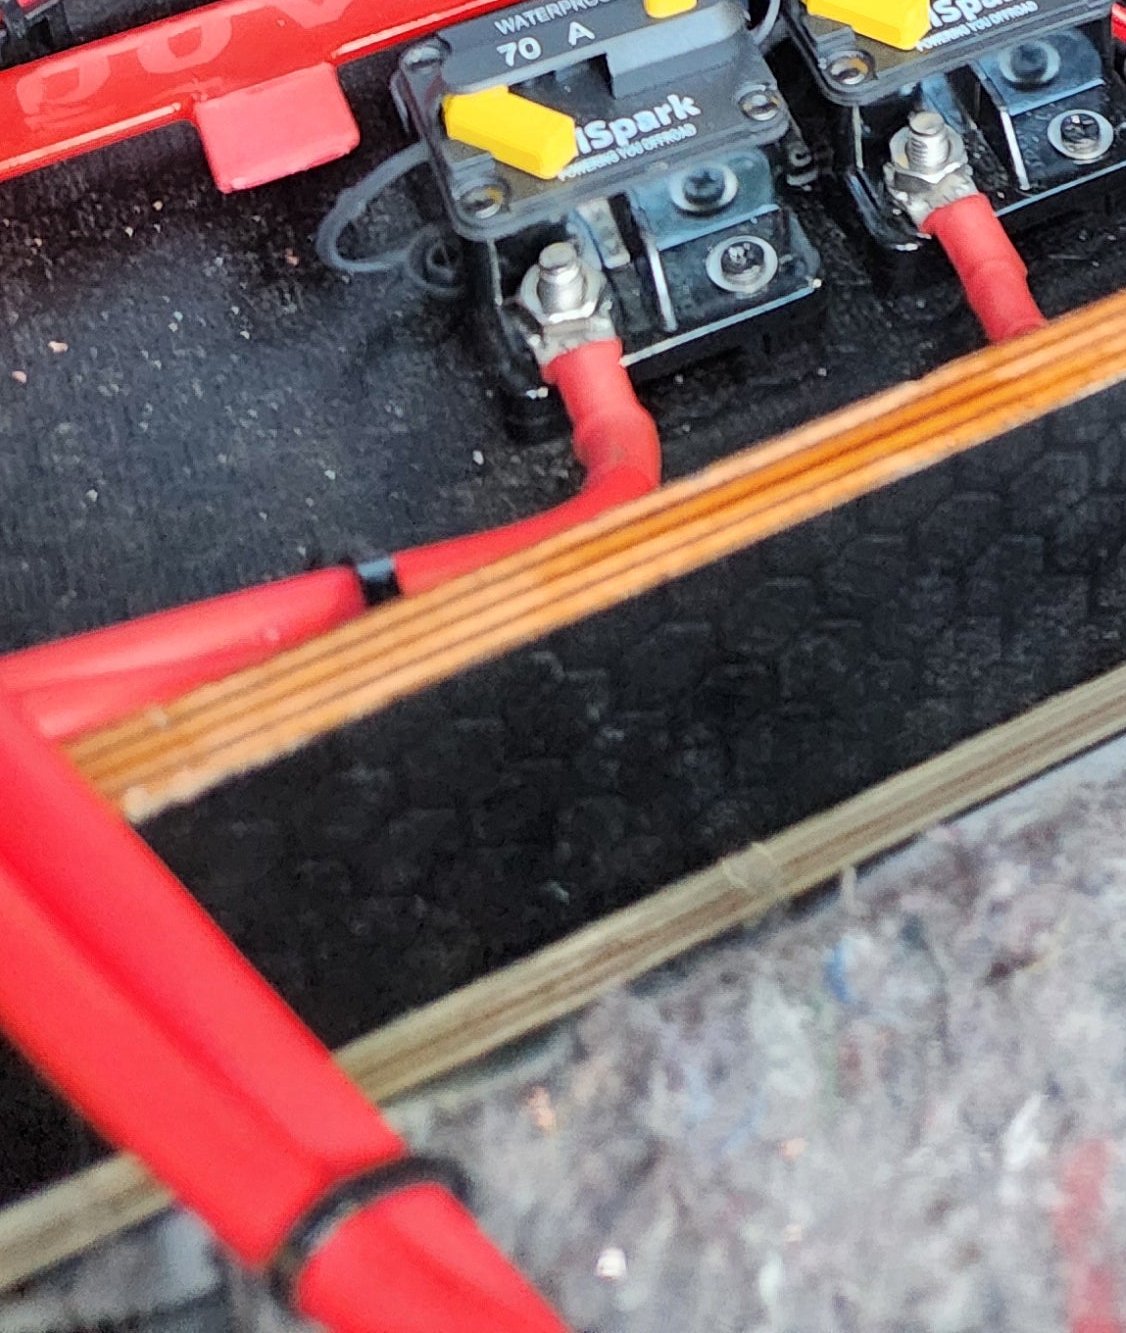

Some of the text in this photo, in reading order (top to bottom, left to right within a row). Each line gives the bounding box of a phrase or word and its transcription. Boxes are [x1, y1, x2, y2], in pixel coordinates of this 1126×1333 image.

[497, 21, 595, 67] 70 A
[575, 93, 702, 155] lSpark
